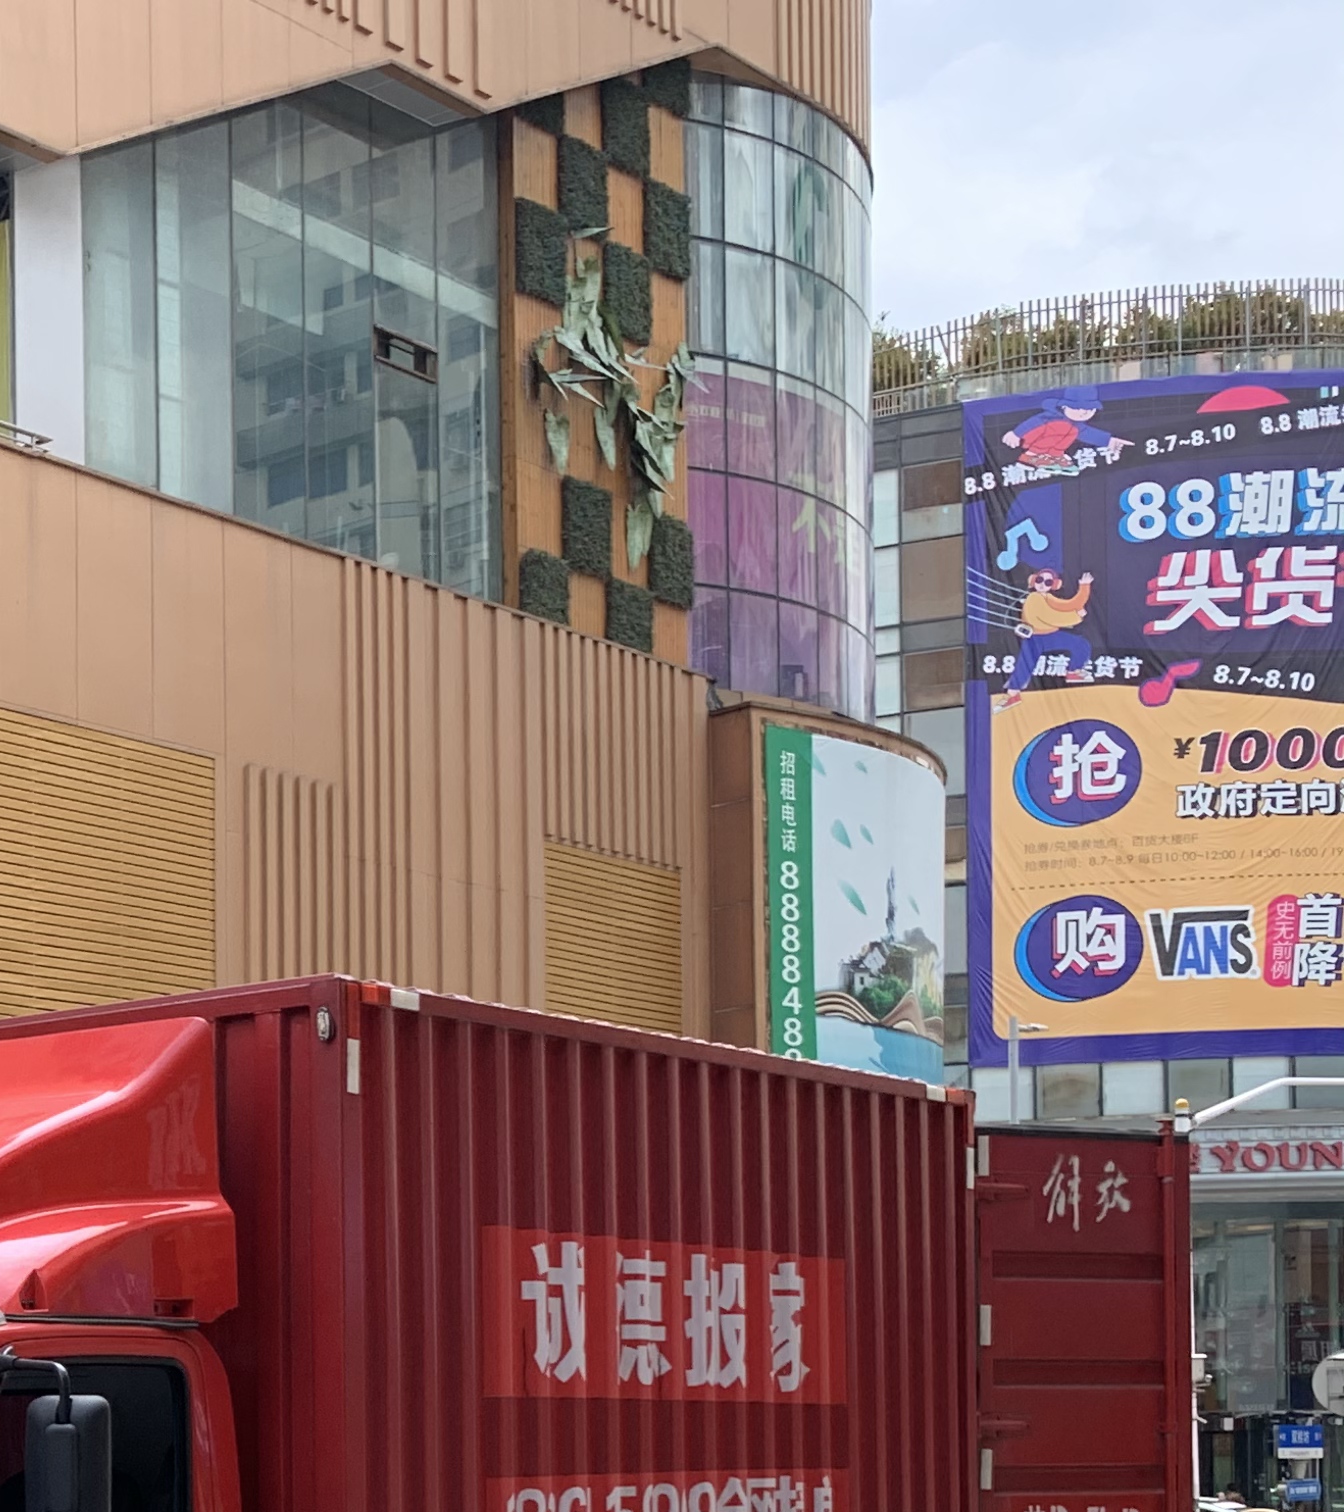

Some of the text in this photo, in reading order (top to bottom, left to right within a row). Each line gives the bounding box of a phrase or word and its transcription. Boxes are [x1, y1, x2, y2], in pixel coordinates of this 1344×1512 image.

[1145, 423, 1237, 456] 8.7~8.10
[1260, 404, 1344, 435] 8.8 潮流
[964, 472, 996, 495] 8.8
[982, 654, 1016, 674] 8.8
[1213, 665, 1315, 692] 8.7~8.10
[1050, 730, 1127, 802] 抢
[1176, 778, 1344, 819] 政府定向
[1052, 907, 1126, 976] 购
[1149, 909, 1254, 977] VANS
[1271, 901, 1295, 980] 史无前例
[1043, 1154, 1131, 1232] 解放
